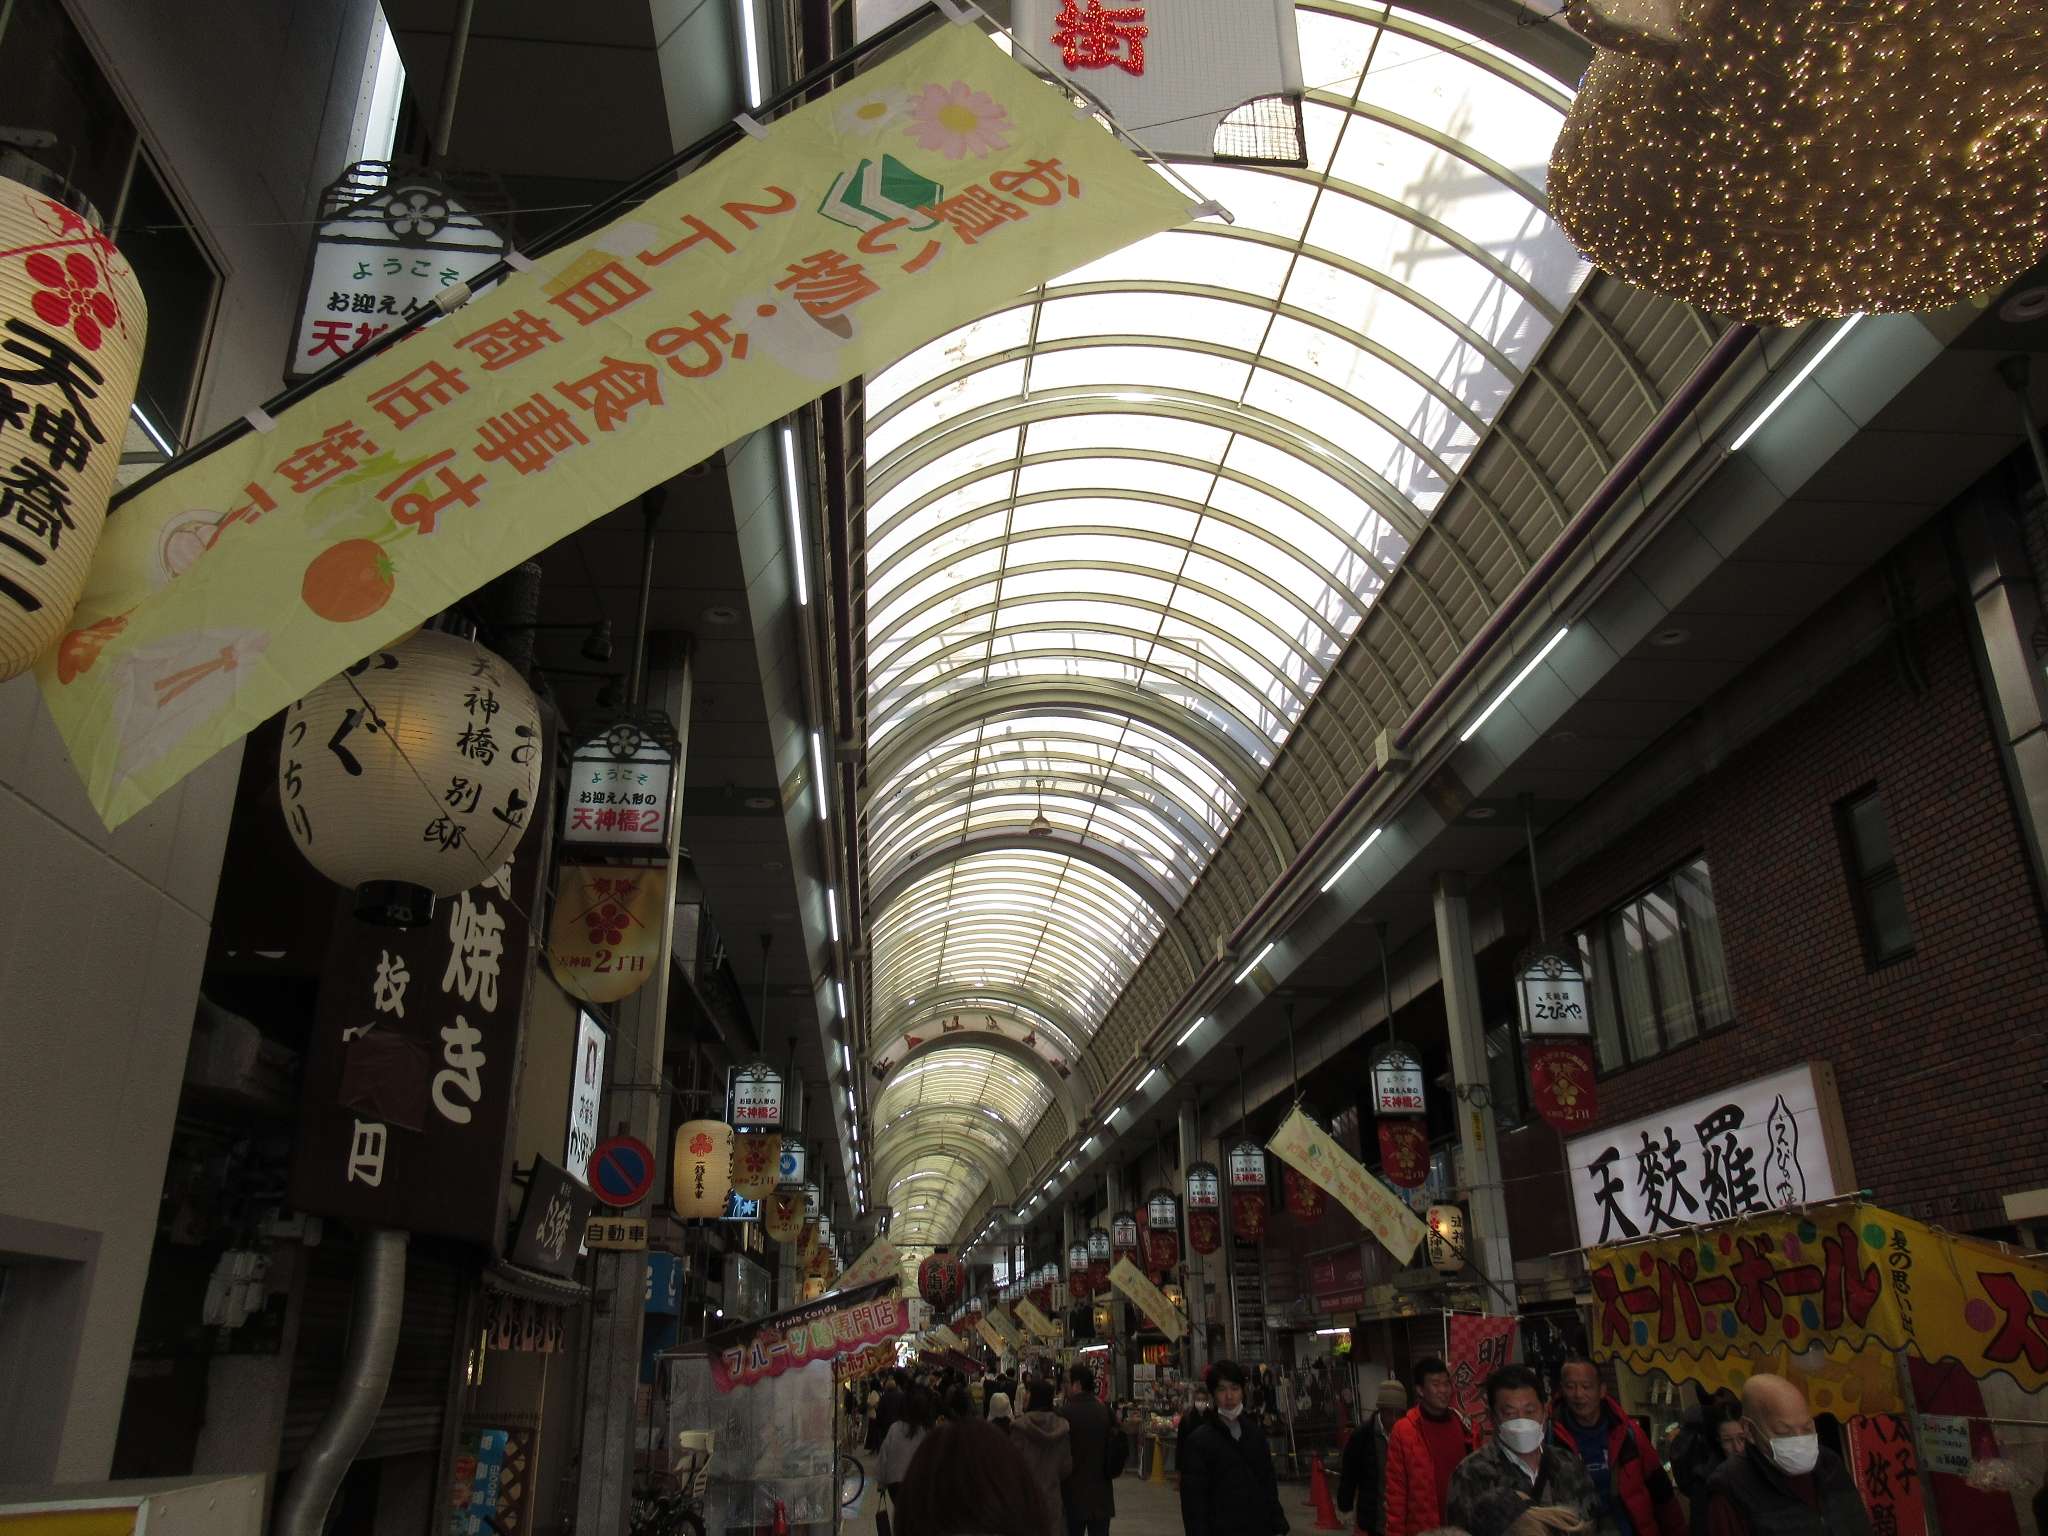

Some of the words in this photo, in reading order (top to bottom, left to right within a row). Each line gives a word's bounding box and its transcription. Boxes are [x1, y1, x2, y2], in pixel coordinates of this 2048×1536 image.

[353, 258, 459, 287] ようこそ
[284, 700, 313, 846] っちり
[592, 768, 648, 785] ようこそ
[580, 791, 657, 806] お迎え人形の
[571, 808, 660, 832] 天神橋2
[736, 1106, 778, 1119] 天神橋2
[347, 1118, 388, 1188] 円
[587, 1224, 647, 1242] 自動車
[1592, 1222, 1882, 1347] スーパーボール
